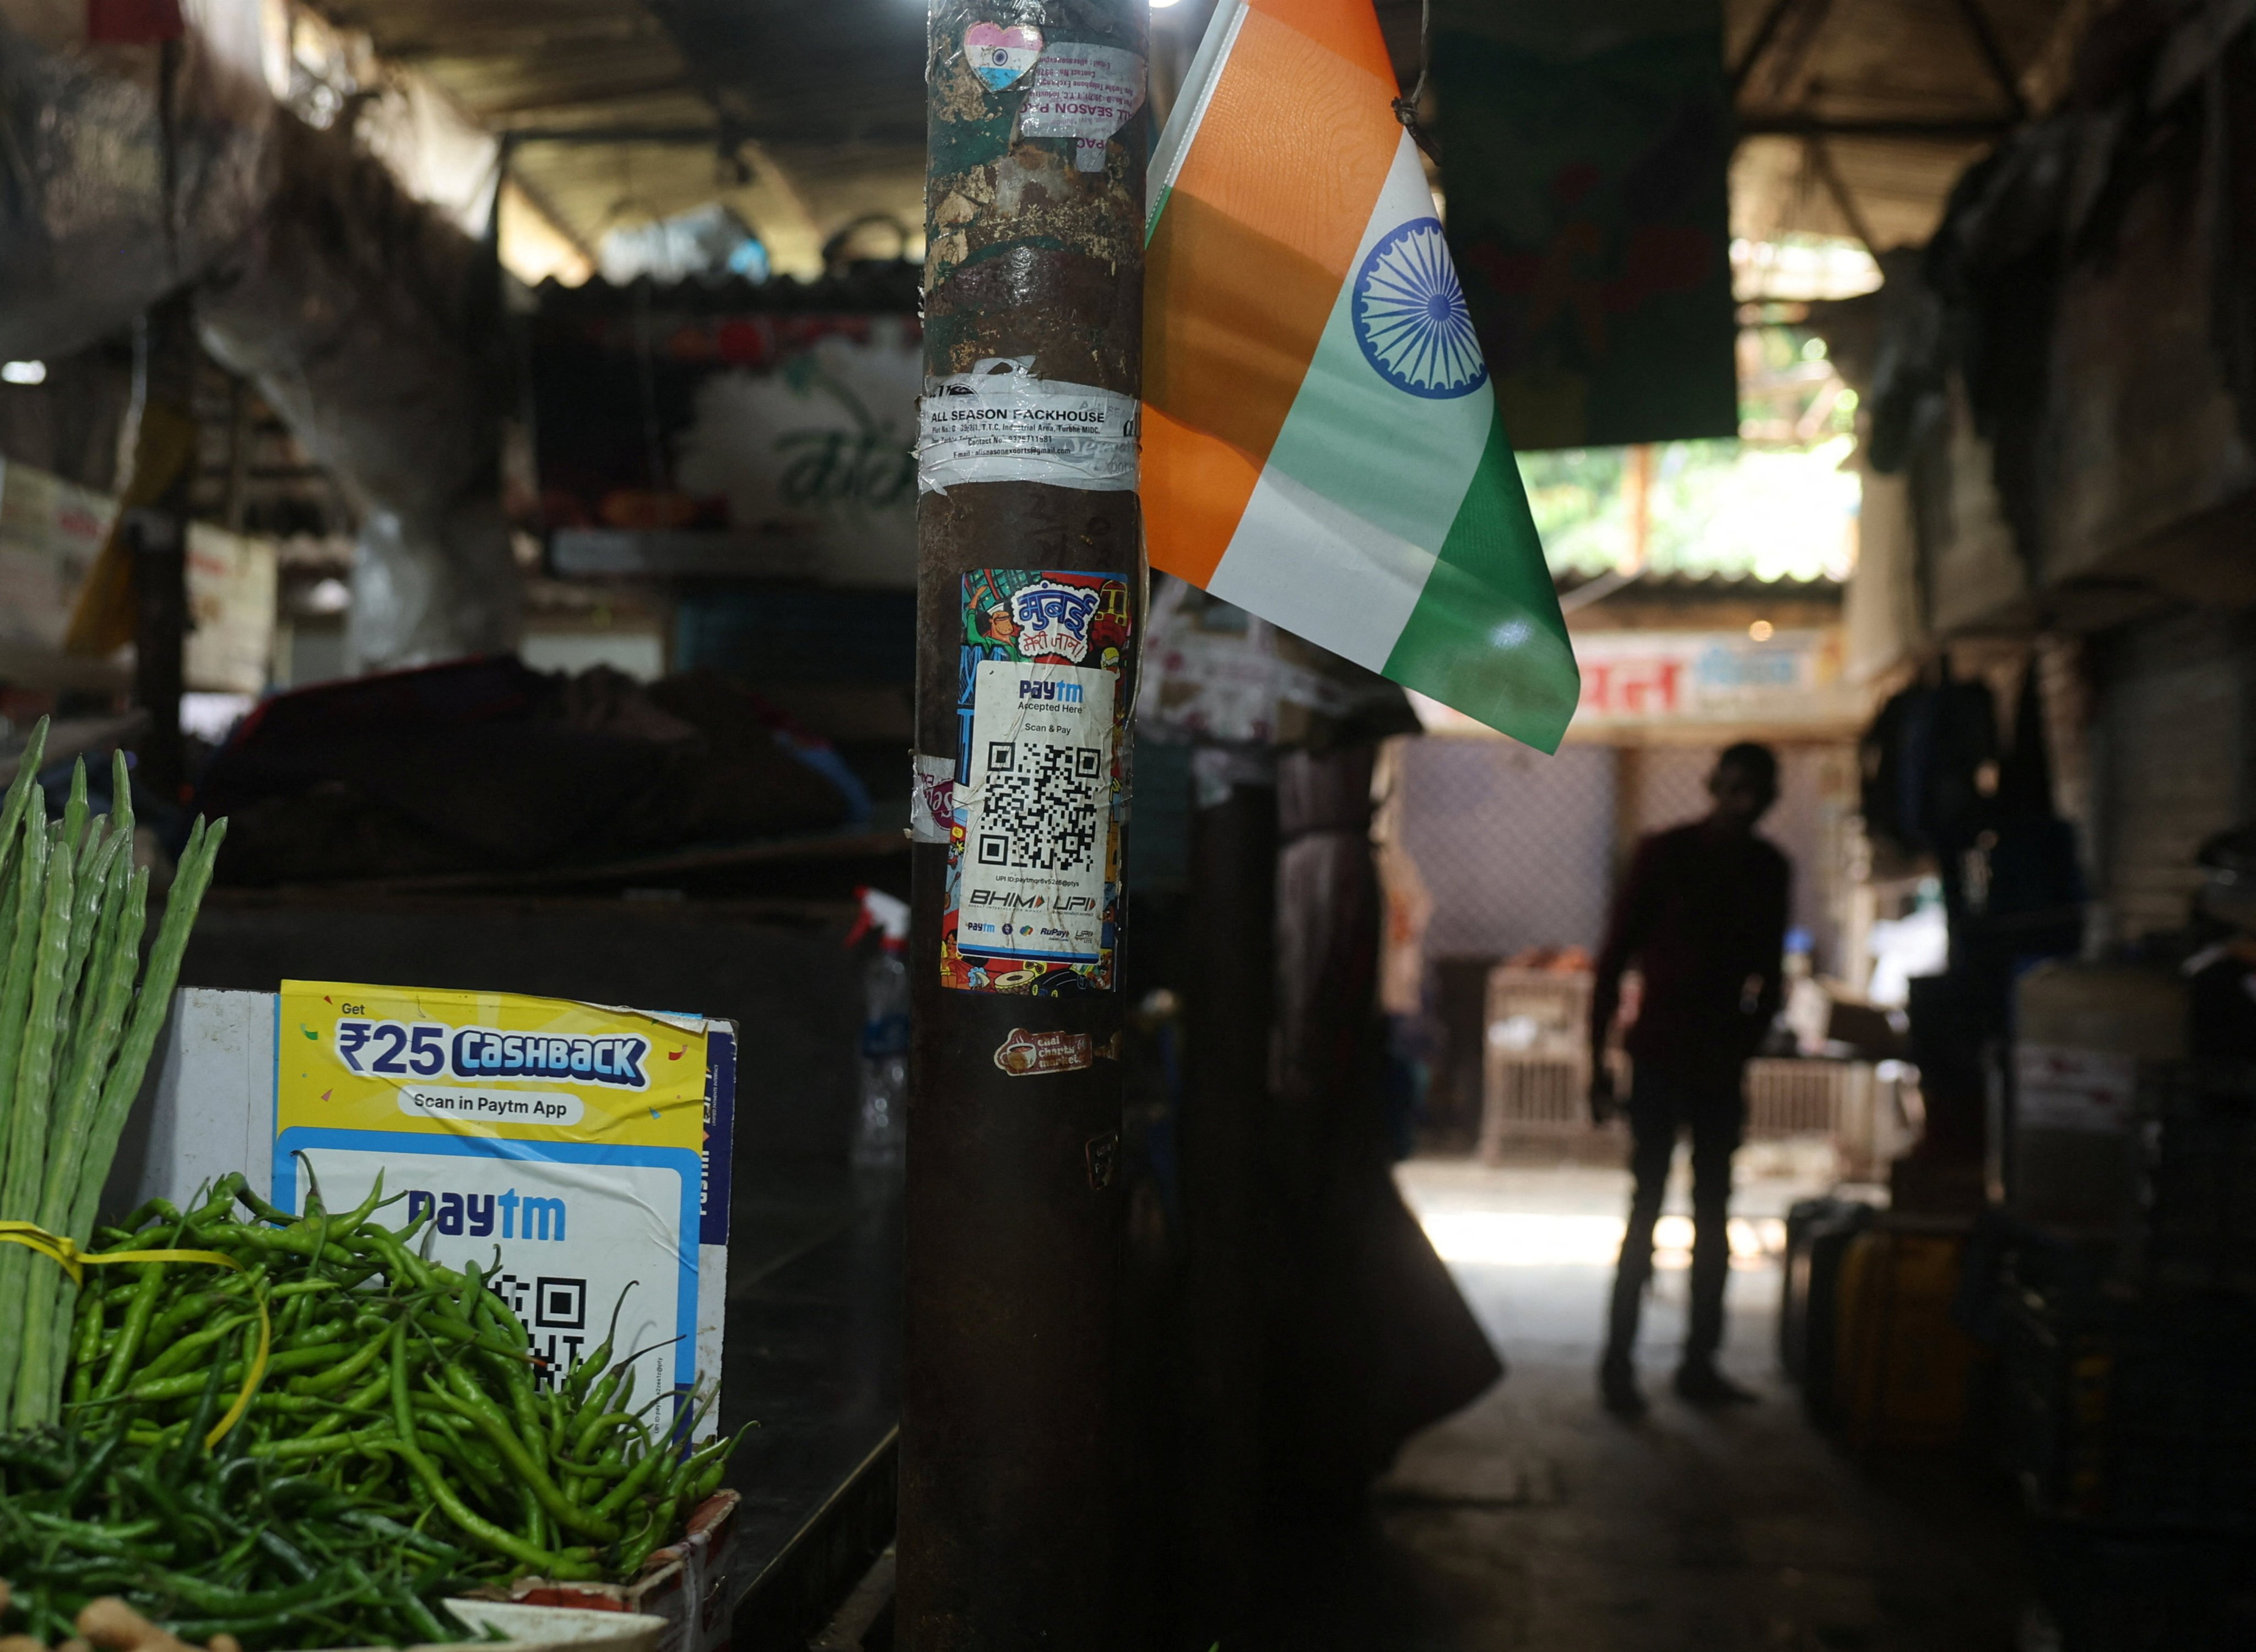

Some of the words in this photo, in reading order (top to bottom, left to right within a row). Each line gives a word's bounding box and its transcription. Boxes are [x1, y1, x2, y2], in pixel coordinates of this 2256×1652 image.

[1071, 69, 1096, 78] Contact
[1073, 80, 1103, 91] Telephone
[1056, 103, 1113, 117] SEASON
[931, 411, 948, 423] ALL
[951, 409, 1007, 420] SEASON
[1013, 409, 1105, 423] PACKHOUSE
[1037, 424, 1056, 433] Area,
[1057, 425, 1080, 434] Turbhe
[968, 437, 991, 446] Contact
[1016, 582, 1100, 641] मुंबई
[1022, 631, 1048, 652] मेरी
[1050, 632, 1085, 658] जान!
[1018, 701, 1061, 712] Accepted
[1062, 704, 1083, 714] Here
[1025, 723, 1046, 732] Scan
[1048, 724, 1054, 733] &
[1056, 725, 1072, 736] Pay
[970, 889, 1036, 909] BHIM
[1052, 895, 1091, 912] UPI
[1040, 928, 1066, 938] RuPay
[342, 1003, 365, 1015] Get
[340, 1022, 445, 1075] ₹25
[414, 1093, 455, 1110] Scan
[458, 1095, 473, 1111] in
[478, 1097, 529, 1115] Paytm
[533, 1101, 567, 1117] App
